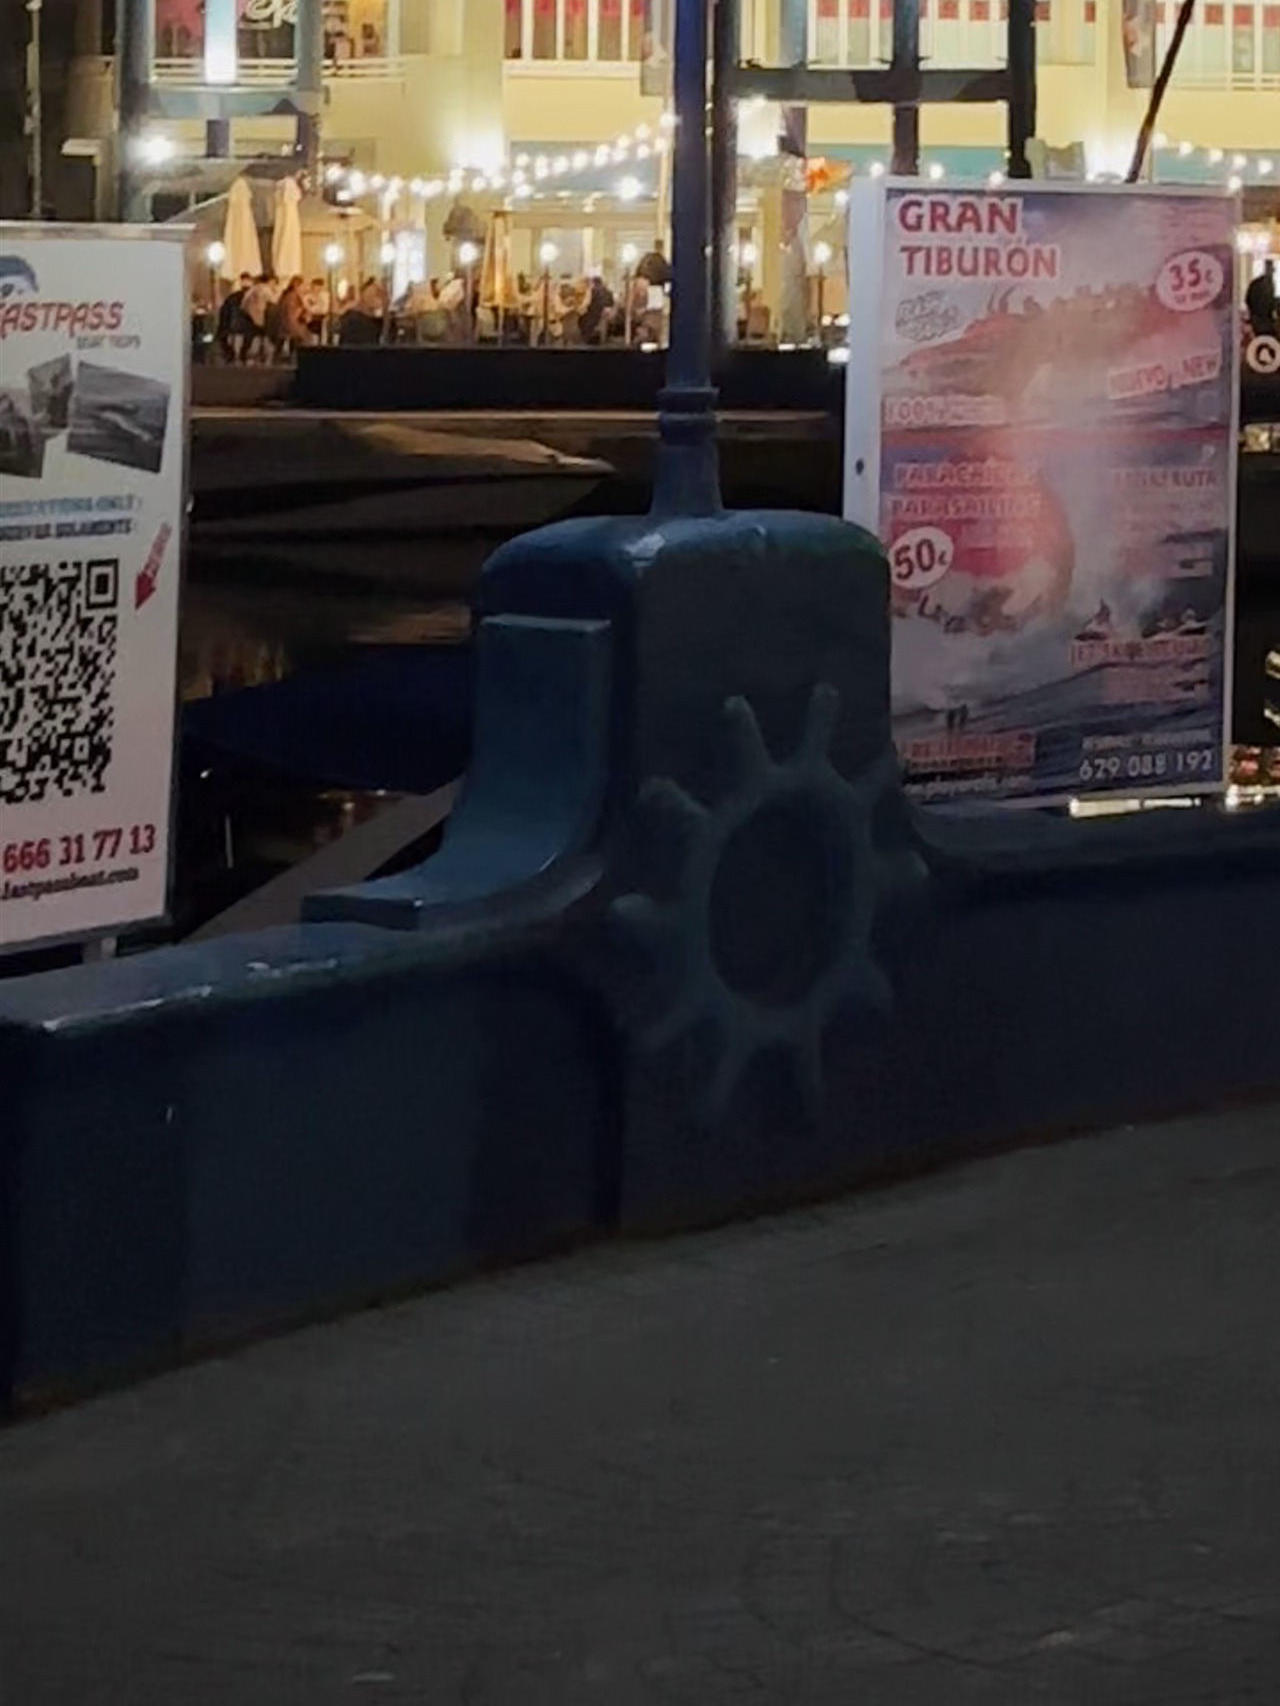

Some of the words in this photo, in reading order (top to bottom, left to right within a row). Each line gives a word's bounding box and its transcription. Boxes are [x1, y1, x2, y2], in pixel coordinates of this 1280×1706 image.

[898, 199, 1018, 234] GRAN
[900, 238, 1057, 277] TIBURÓN
[1127, 752, 1167, 778] 088
[1175, 748, 1214, 773] 192
[3, 838, 51, 873] 666
[59, 834, 85, 865] 31
[93, 828, 123, 861] 77
[129, 824, 156, 855] 13
